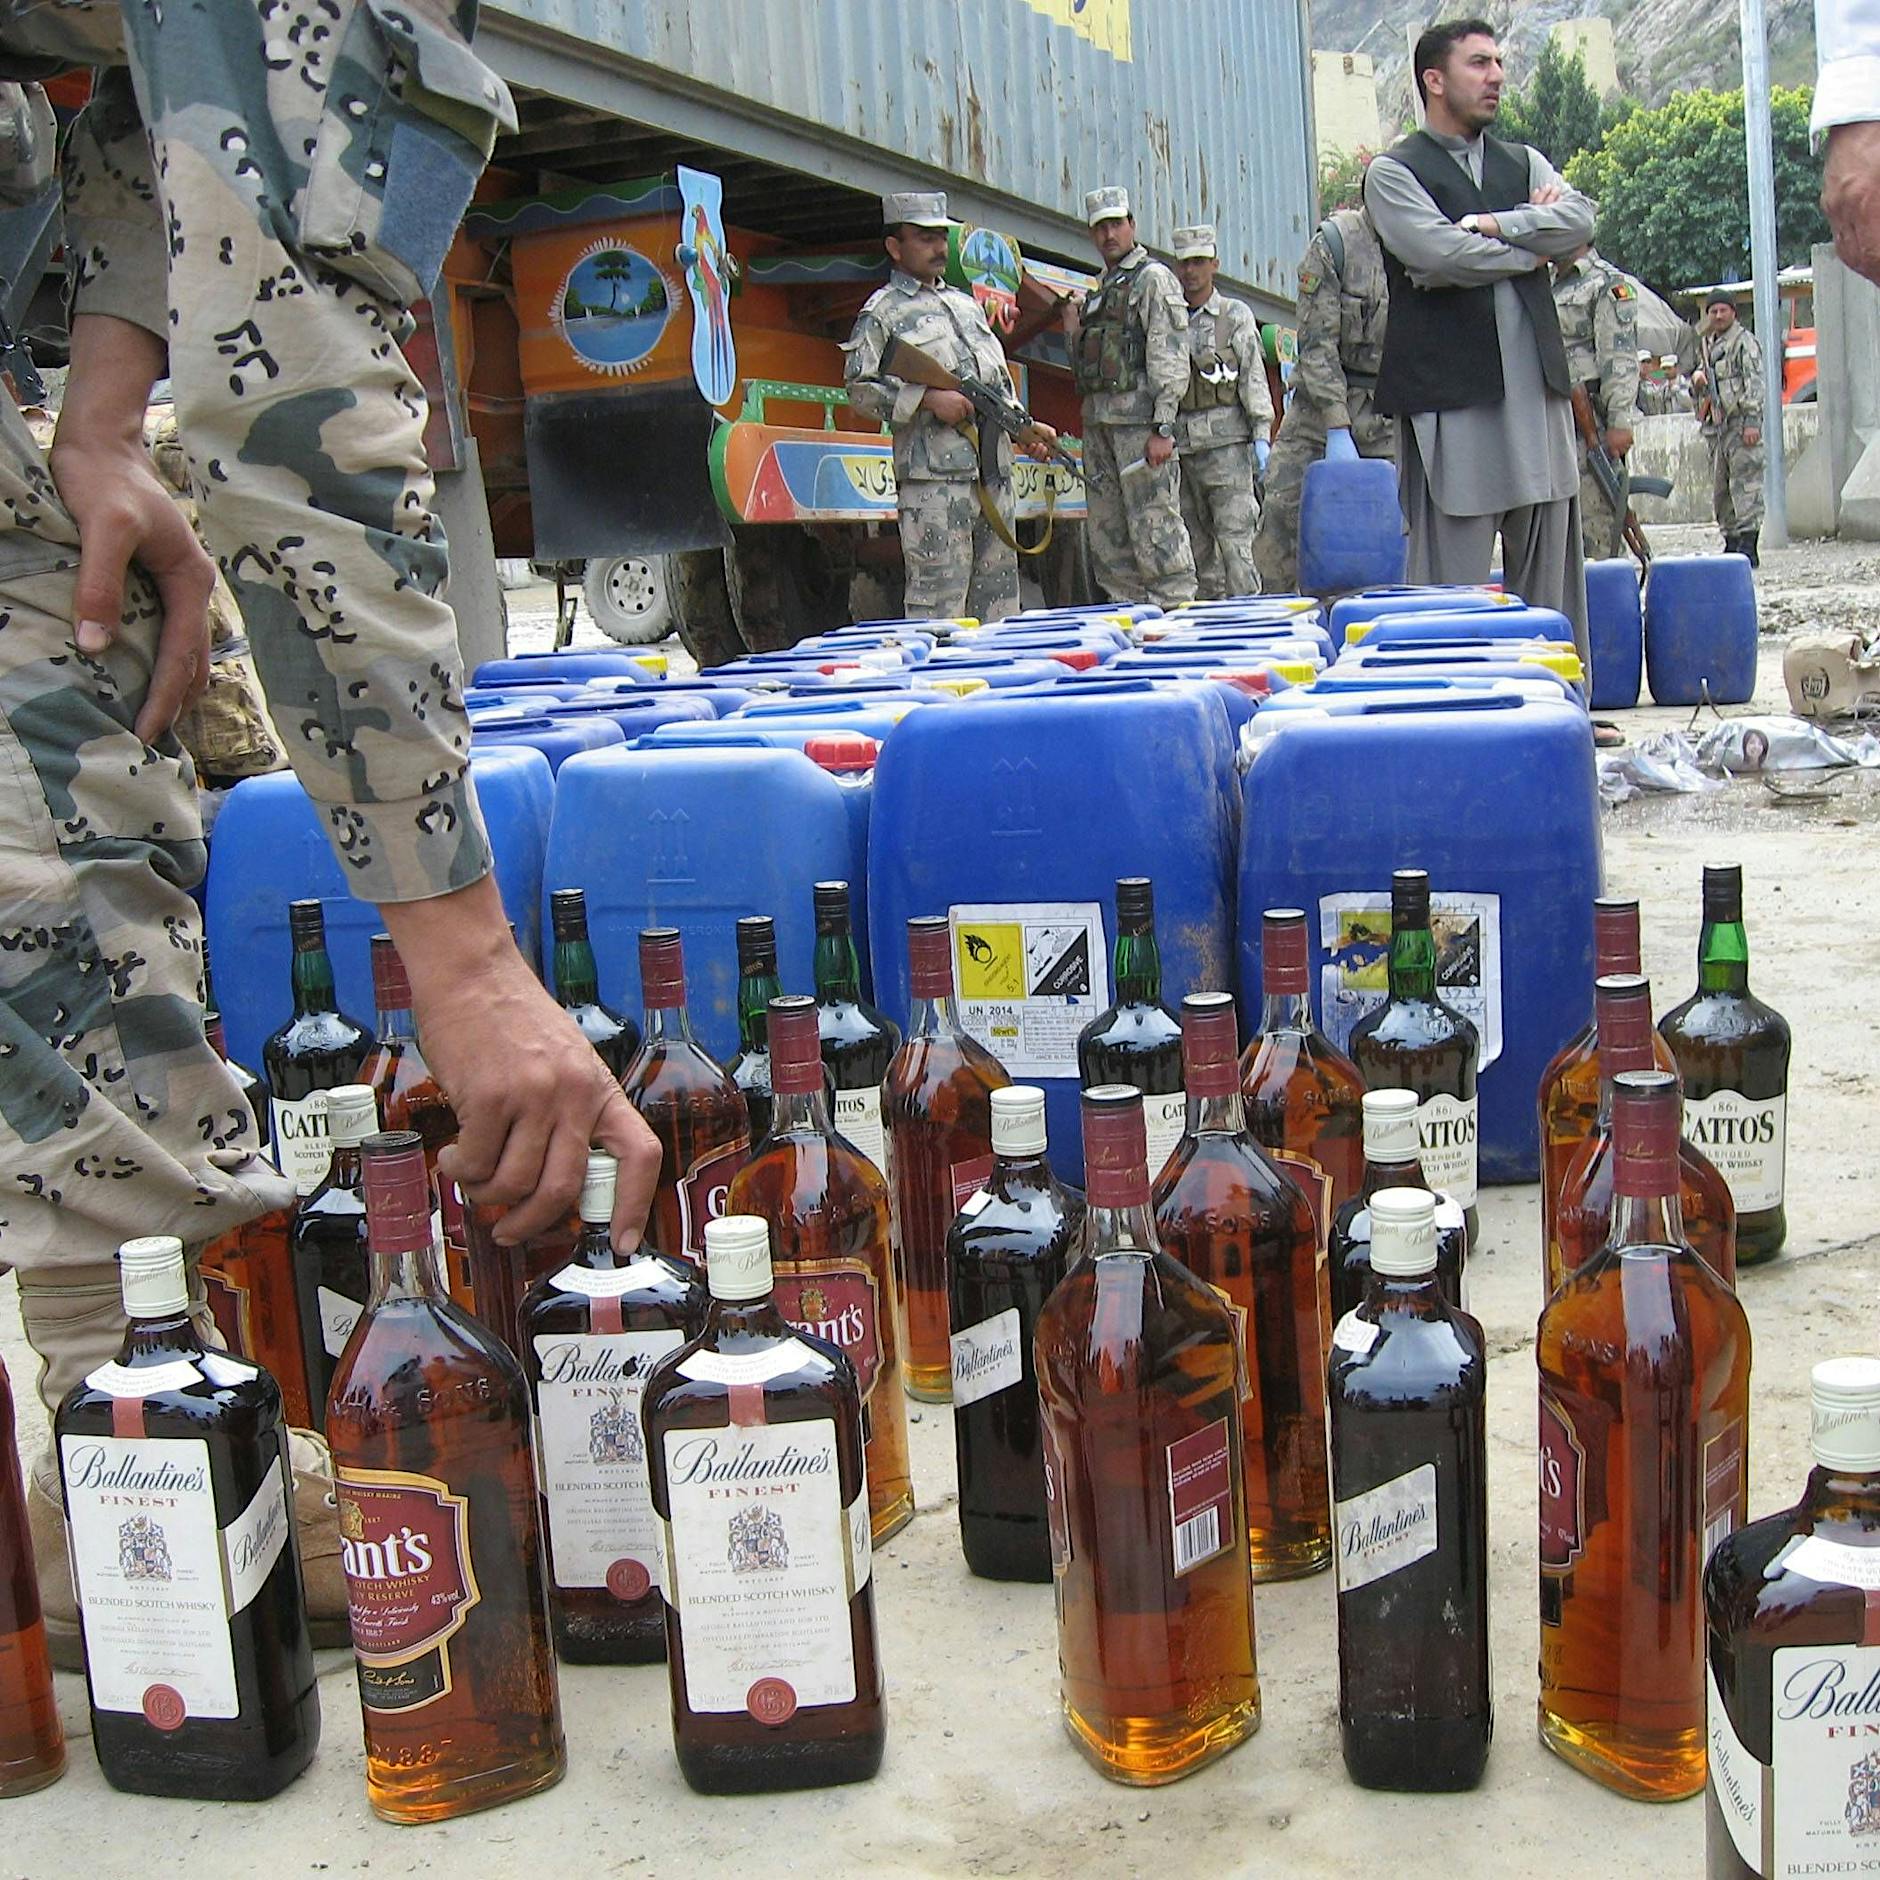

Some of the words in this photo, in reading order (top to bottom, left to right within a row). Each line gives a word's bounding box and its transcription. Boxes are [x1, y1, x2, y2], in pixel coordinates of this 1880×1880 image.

[1053, 955, 1084, 989] CORROSIVE
[968, 1005, 984, 1016] UN
[989, 1005, 1014, 1016] 2014
[1431, 1107, 1453, 1118] 1861
[1713, 1102, 1739, 1113] 1861
[66, 1444, 206, 1492] Ballantine's
[670, 1437, 831, 1486] Ballantine's
[555, 1482, 602, 1492] BLENDED
[708, 1483, 800, 1499] FINEST
[99, 1495, 180, 1509] FINEST
[1341, 1503, 1425, 1558] Ballantine's
[386, 1573, 431, 1589] WHISKY
[368, 1590, 414, 1602] RESERVE
[689, 1593, 742, 1606] BLENDED
[743, 1591, 789, 1601] SCOTCH
[791, 1585, 837, 1597] WHISKY
[88, 1596, 133, 1607] BLENDED
[134, 1599, 175, 1609] SCOTCH
[177, 1601, 217, 1612] WHISKY
[1786, 1860, 1857, 1874] BLENDED
